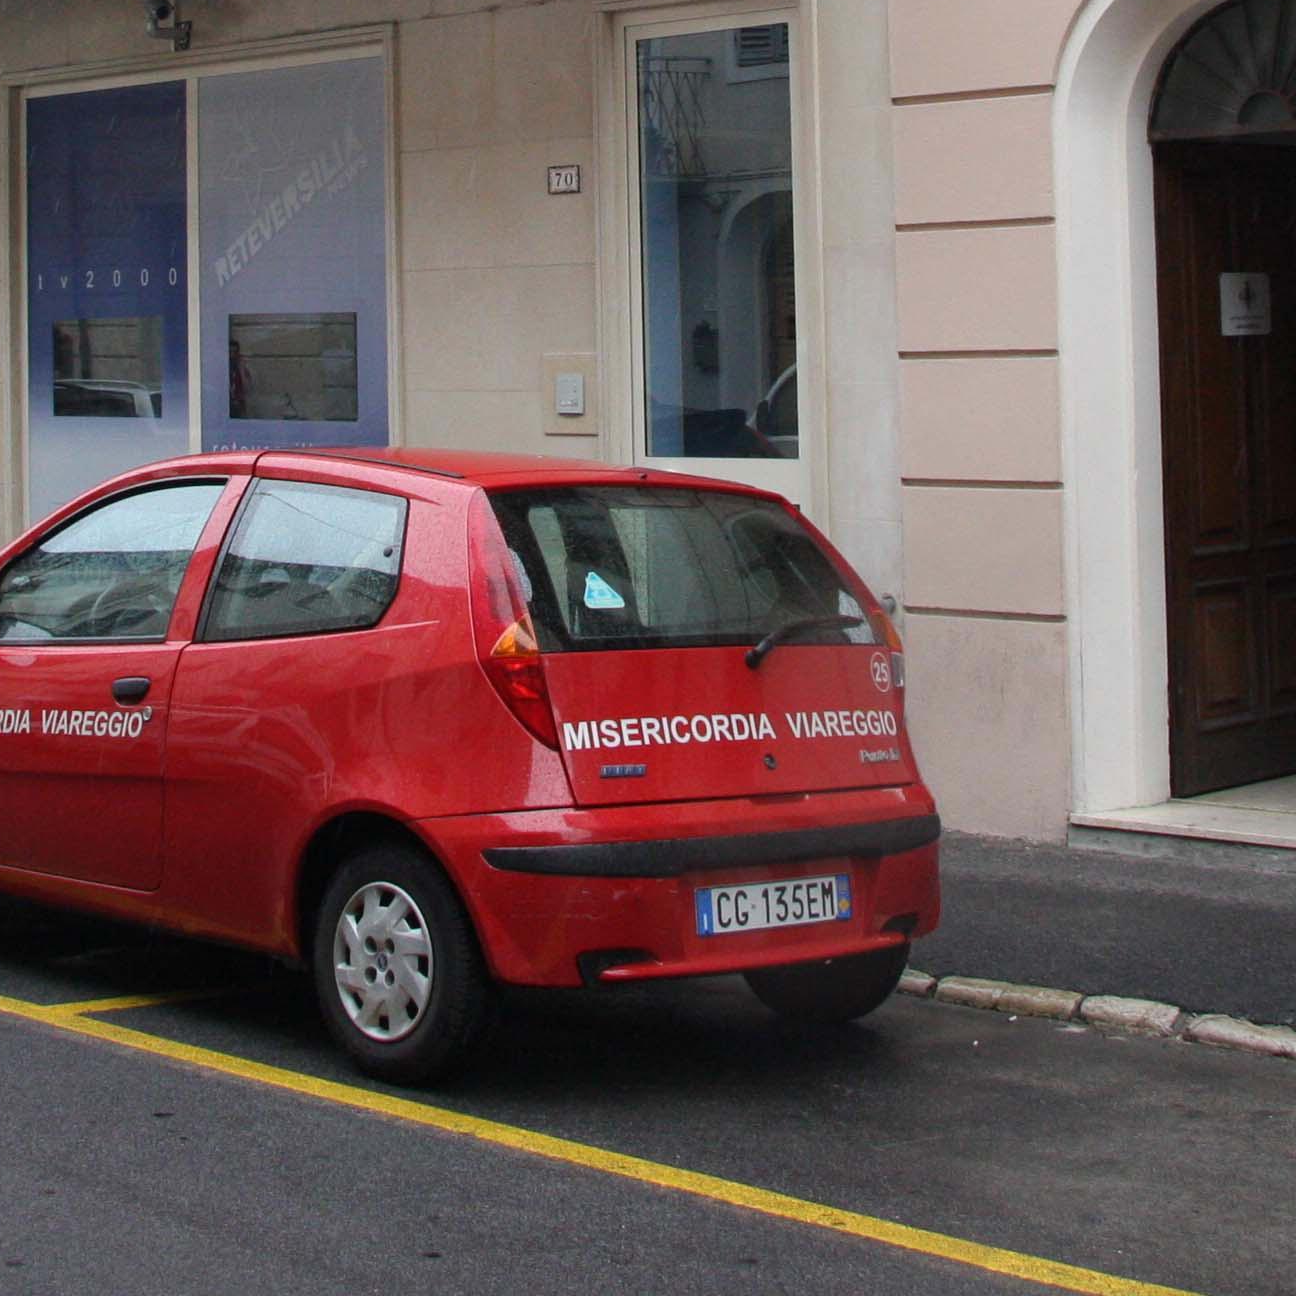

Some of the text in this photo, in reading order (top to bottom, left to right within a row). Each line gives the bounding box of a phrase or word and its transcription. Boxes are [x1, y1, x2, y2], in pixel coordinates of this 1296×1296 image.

[554, 172, 574, 188] 70
[873, 661, 889, 683] 25
[40, 709, 144, 738] VIAREGGIO
[562, 710, 898, 751] MISERICORDIA VIAREGGIO
[716, 889, 750, 929] CG
[761, 880, 836, 924] 135EM
